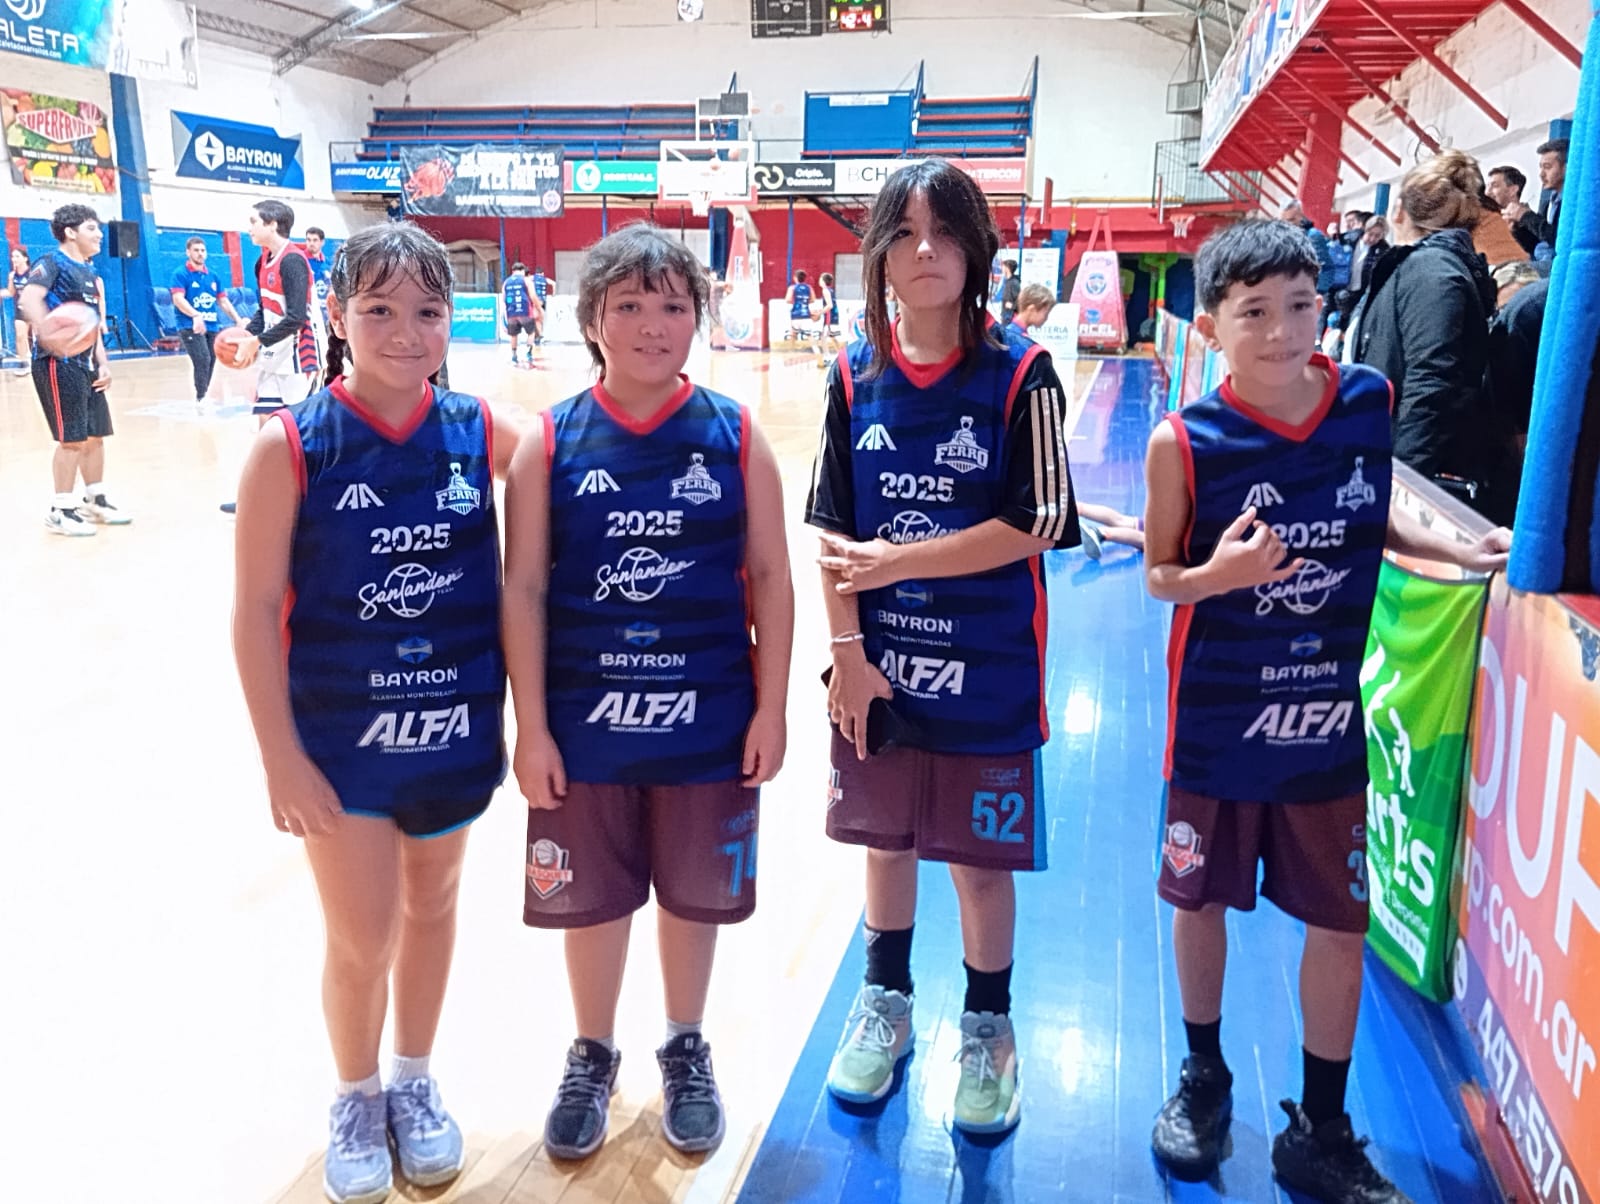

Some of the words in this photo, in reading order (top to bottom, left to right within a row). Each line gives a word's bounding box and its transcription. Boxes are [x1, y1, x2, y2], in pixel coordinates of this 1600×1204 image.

[18, 108, 94, 141] SUPERFRUTA
[226, 146, 283, 169] BAYRON
[934, 445, 989, 470] FERRO
[435, 489, 480, 511] FERRO
[671, 479, 722, 499] FERRO
[879, 472, 954, 503] 2025
[606, 510, 684, 537] 2025
[1270, 520, 1346, 549] 2025
[370, 523, 451, 554] 2025
[878, 609, 953, 634] BAYRON
[600, 653, 686, 667] BAYRON
[1261, 660, 1338, 681] BAYRON
[371, 667, 458, 687] BAYRON
[585, 690, 697, 726] ALFA
[1242, 701, 1354, 739] ALFA
[357, 703, 470, 747] ALFA
[971, 791, 1026, 843] 52
